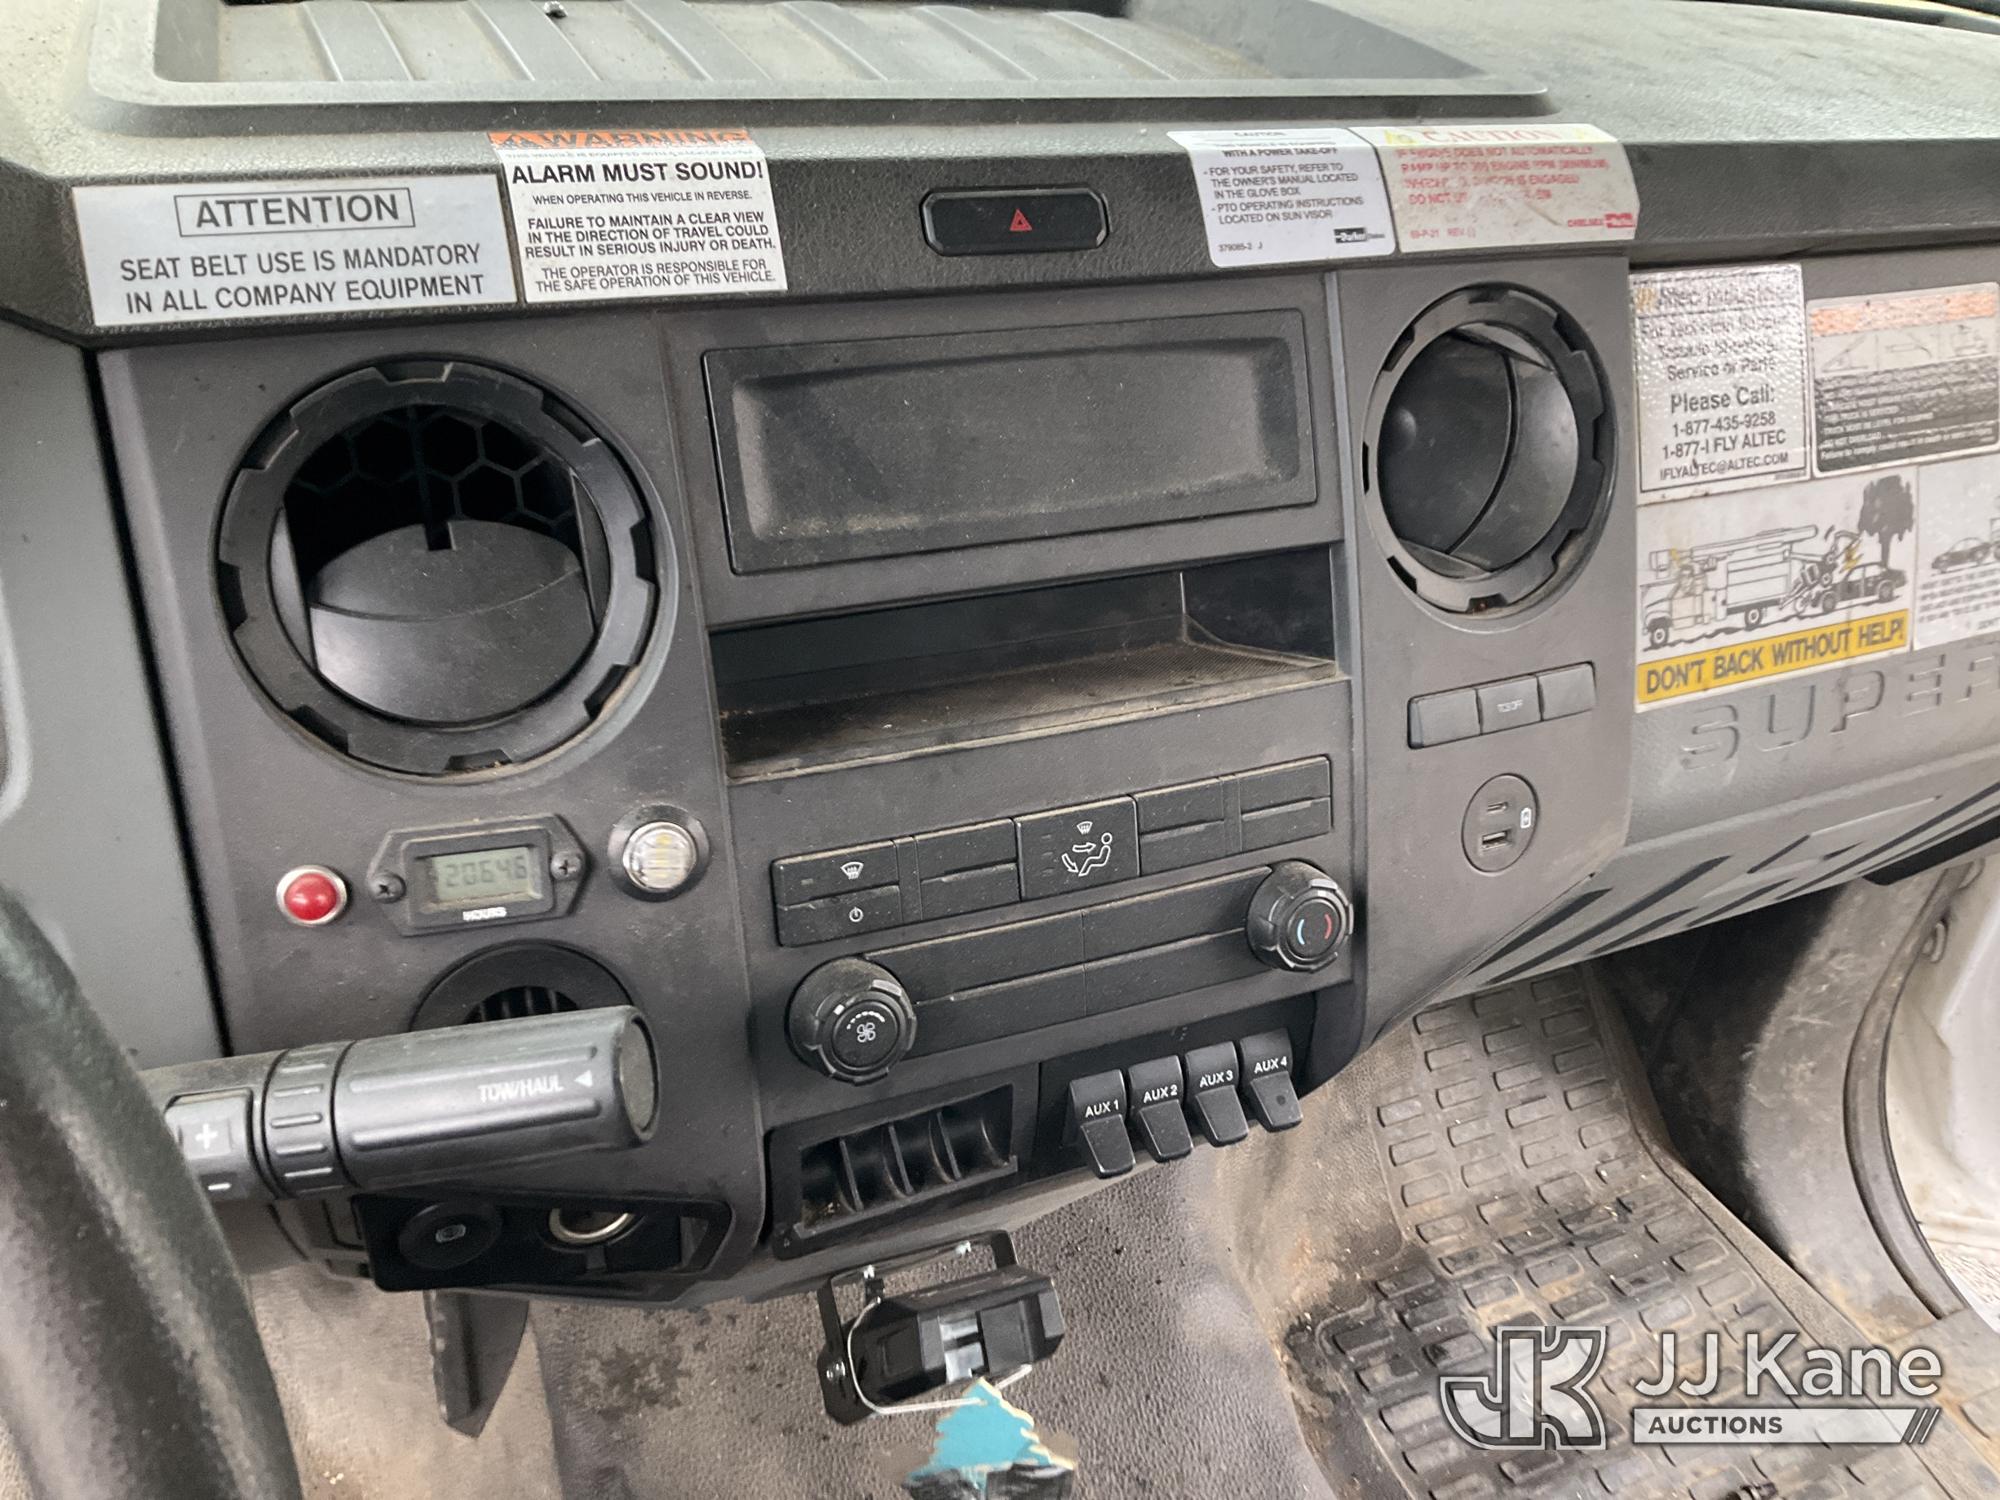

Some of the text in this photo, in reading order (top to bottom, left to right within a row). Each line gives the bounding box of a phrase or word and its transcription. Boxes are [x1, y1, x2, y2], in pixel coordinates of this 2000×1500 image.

[1222, 149, 1249, 158] WITH
[1249, 149, 1258, 157] A
[1258, 148, 1293, 157] POWER
[512, 161, 764, 184] ALARM MUST SOUND!
[1209, 166, 1231, 177] FOR
[1232, 165, 1259, 176] YOUR
[1300, 163, 1330, 173] REFER
[1331, 162, 1344, 172] TO
[1211, 173, 1359, 188] THE OWNER'S MANUAL LOCATED
[532, 190, 753, 205] WHEN OPERATING THIS VEHICLE IN REVERSE.
[1214, 189, 1226, 199] IN
[1227, 189, 1246, 198] THE
[1247, 187, 1279, 197] GLOVE
[195, 193, 400, 229] ATTENTION
[1217, 196, 1364, 213] PTO OPERATING INSTRUCTIONS
[527, 211, 765, 230] FAILURE TO MAINTAIN A CLEAR VIEW
[1219, 209, 1333, 225] LOCATED ON SUN VISOR
[527, 224, 769, 244] IN THE DIRECTION OF TRAVEL COULD
[525, 238, 777, 259] RESULT IN SERIOUS INJURY OR DEATH.
[119, 243, 481, 282] SEAT BELT USE IS MANDATORY
[541, 258, 768, 280] THE OPERATOR IS RESPONSIBLE FOR
[535, 270, 777, 293] THE SAFE OPERATION OF THIS VEHICLE.
[126, 274, 484, 314] IN ALL COMPANY EQUIPMENT
[1667, 364, 1720, 382] Service
[1670, 383, 1775, 414] Please Call:
[1672, 410, 1777, 438] 1-877-435-9258
[1713, 435, 1739, 453] FLY
[1742, 428, 1787, 449] ALTEC
[1659, 452, 1789, 481] IFLYALTEC@ALTEC.COM
[1645, 615, 1905, 695] DON'T BACK WITHOUT HELP!
[1680, 641, 2000, 770] SUPER
[1254, 1056, 1288, 1074] AUX 4
[477, 1073, 565, 1103] TOW/HAUL
[1199, 1070, 1235, 1088] AUX 3
[1143, 1085, 1178, 1103] AUX 2
[1085, 1099, 1120, 1118] AUX 1
